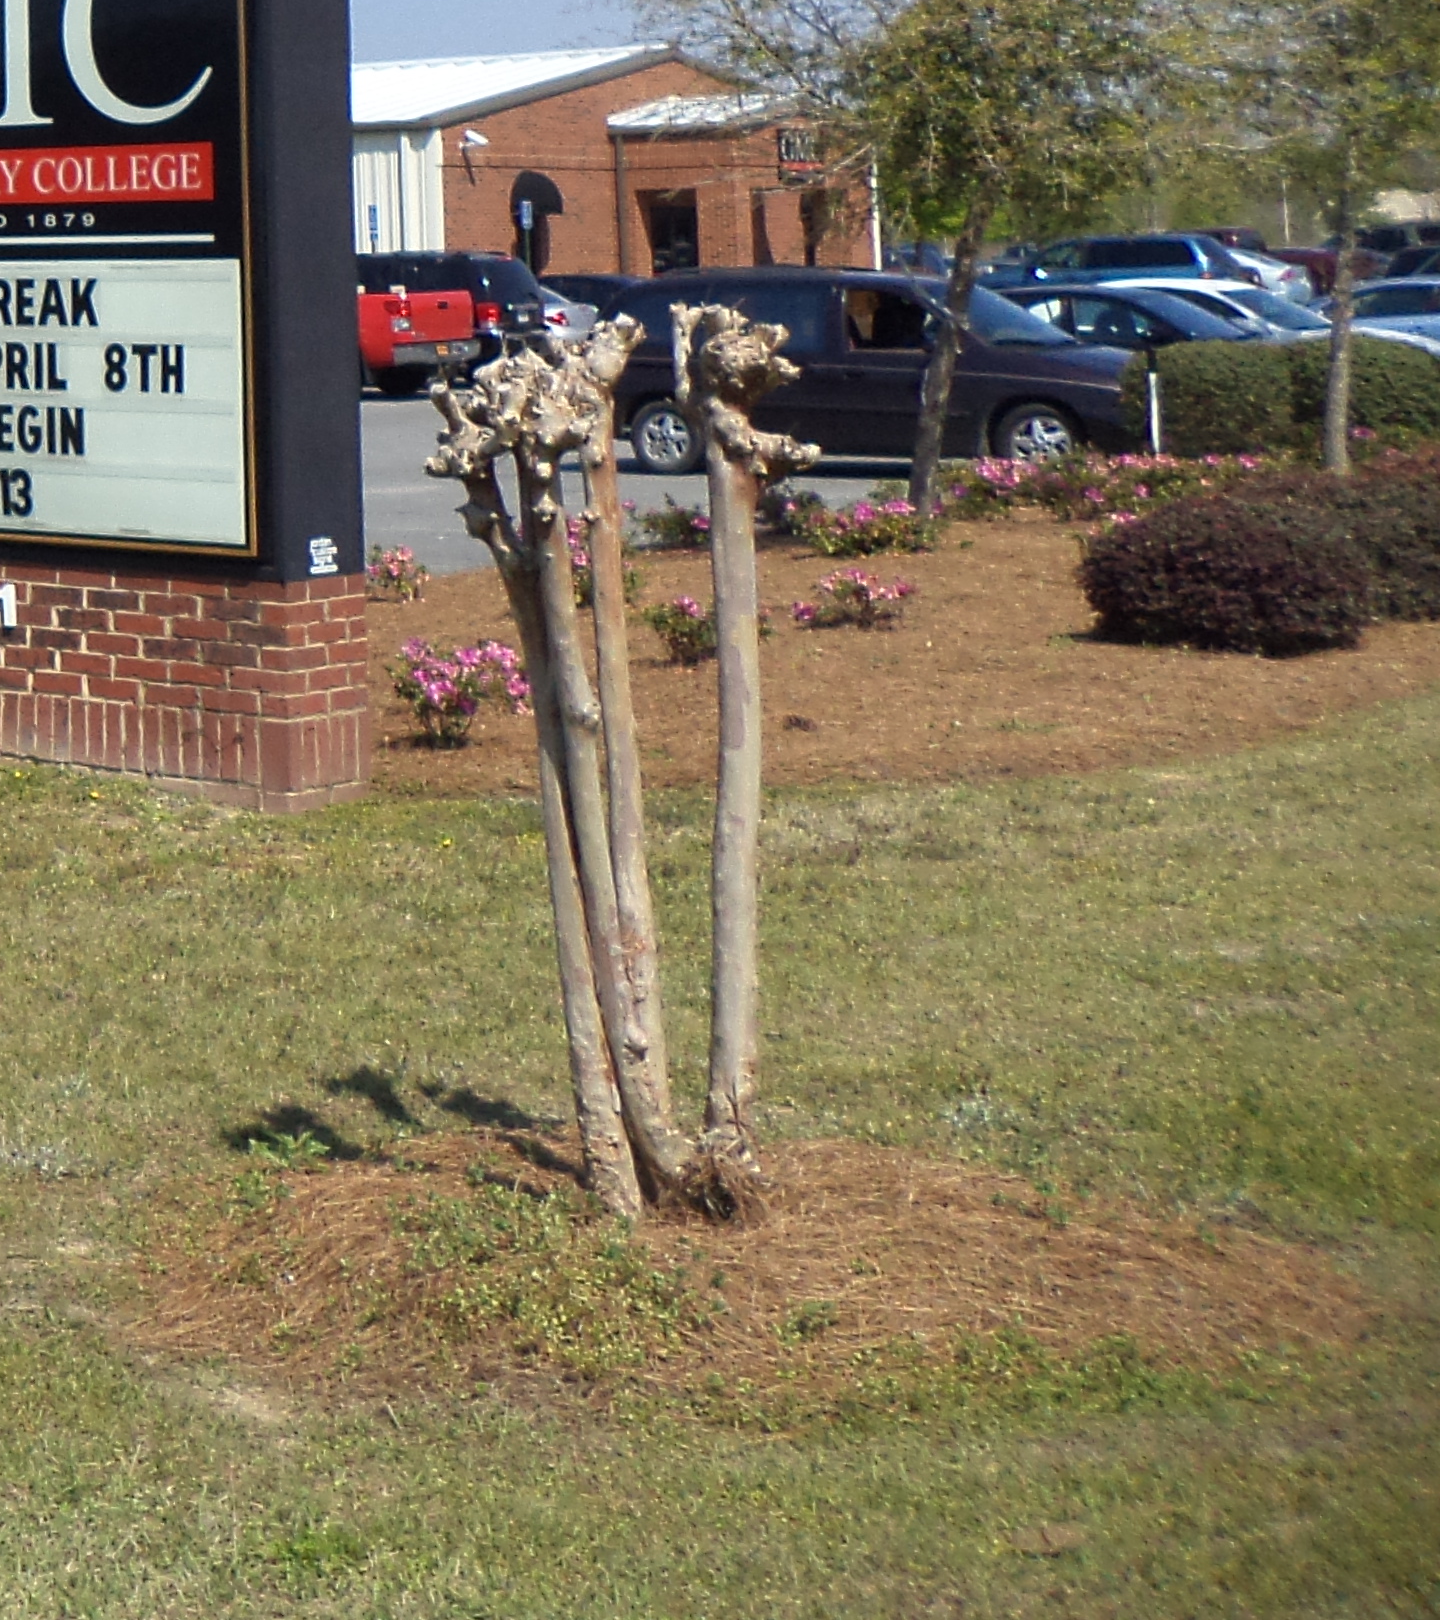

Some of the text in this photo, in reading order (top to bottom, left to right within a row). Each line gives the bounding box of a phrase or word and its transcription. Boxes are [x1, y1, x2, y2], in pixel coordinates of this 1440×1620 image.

[32, 153, 202, 194] COLLEGE
[26, 212, 95, 227] 1879
[104, 343, 185, 394] 8TH
